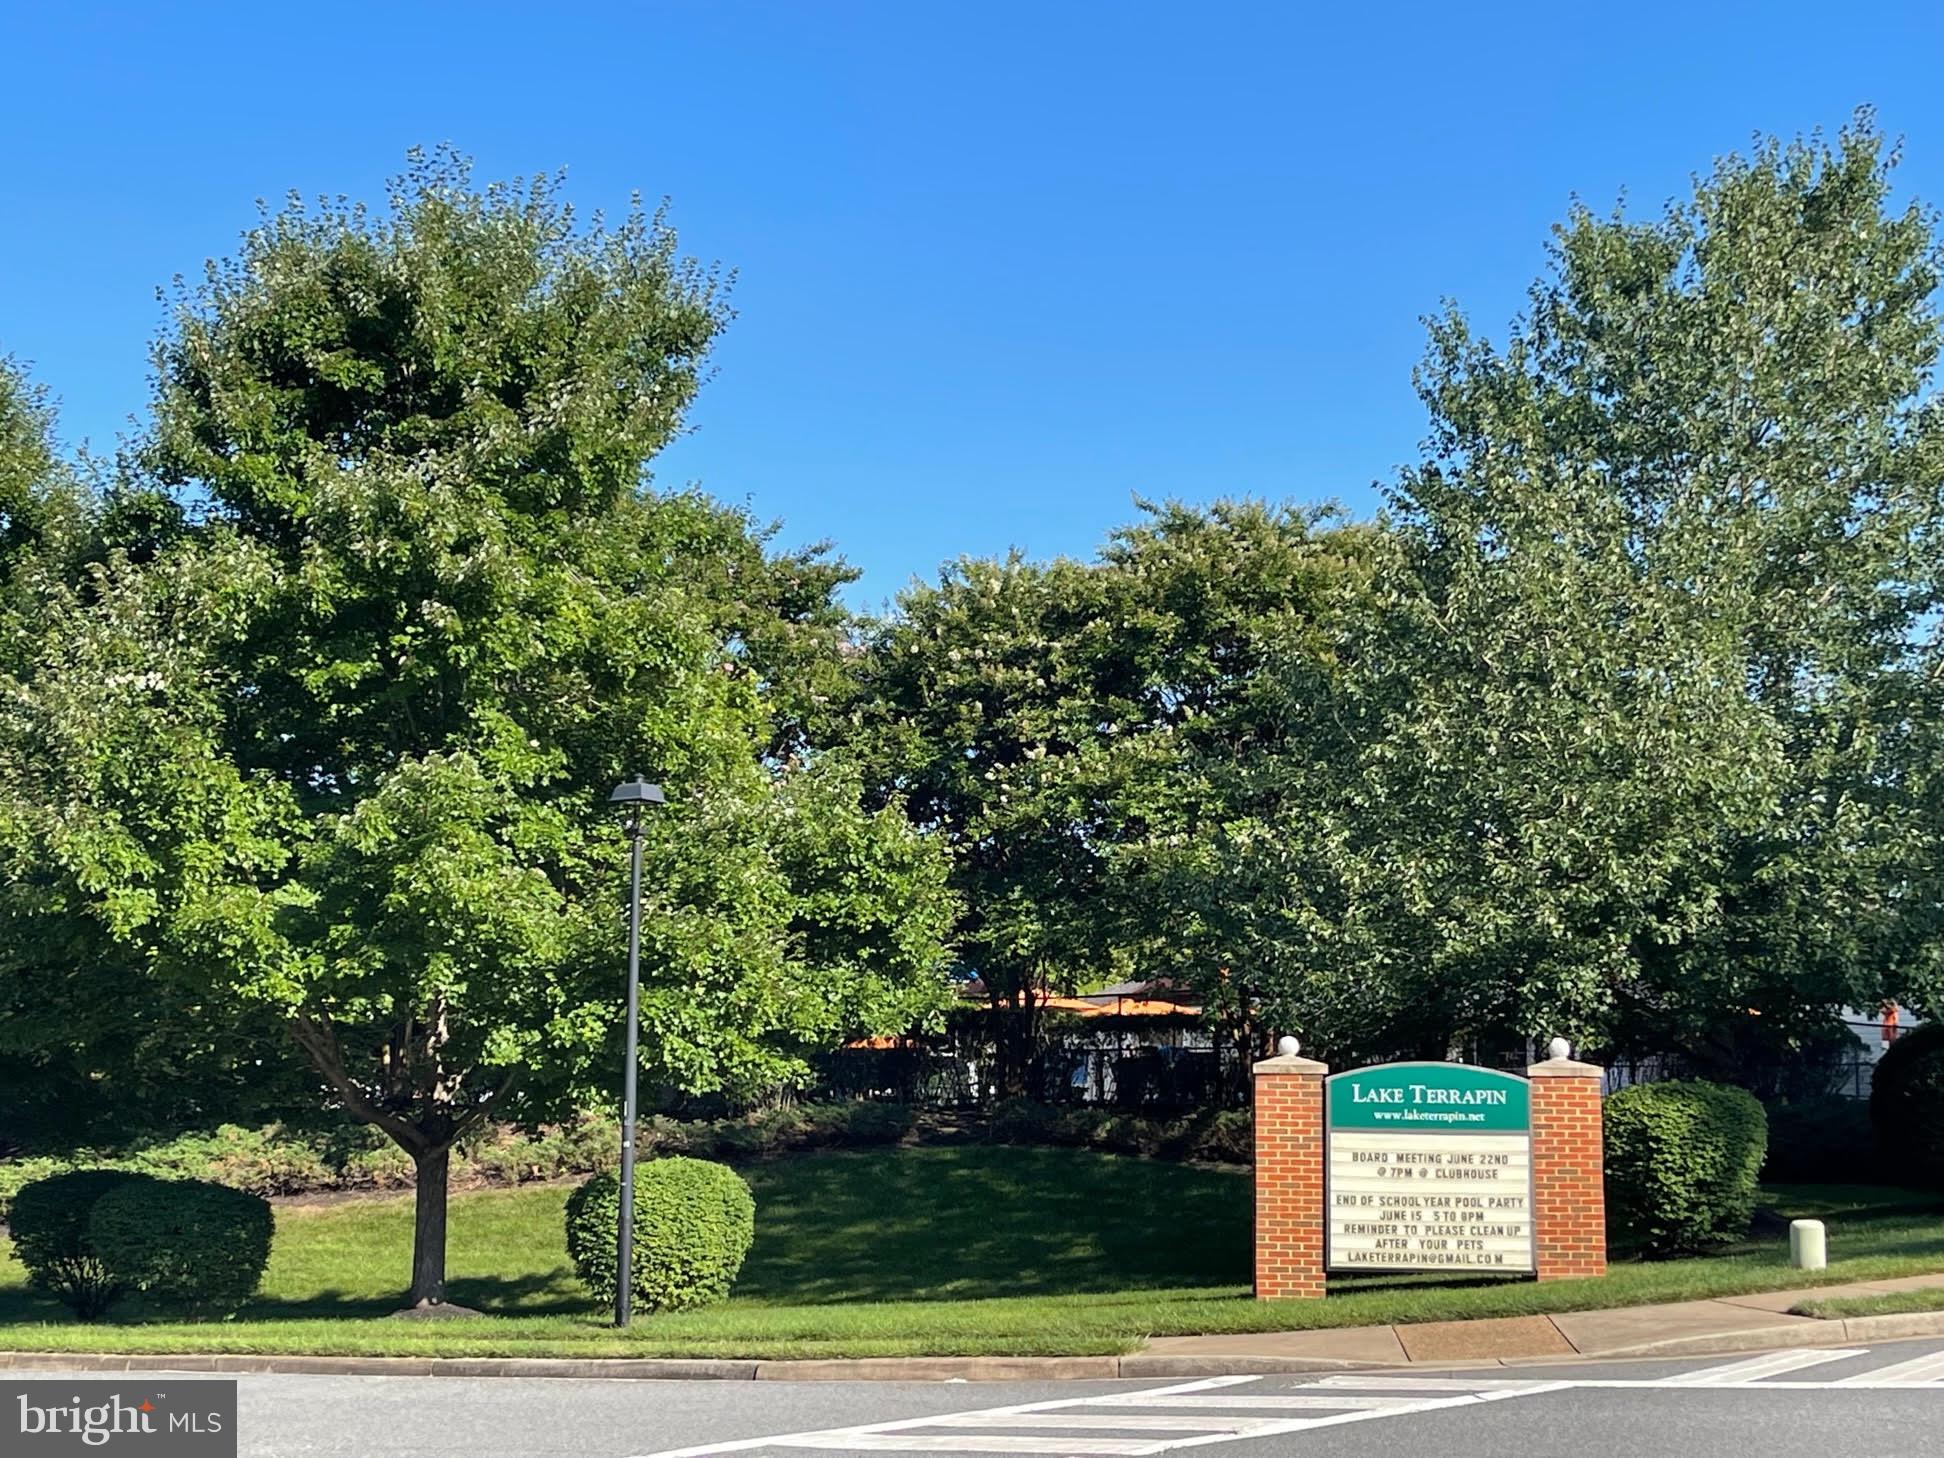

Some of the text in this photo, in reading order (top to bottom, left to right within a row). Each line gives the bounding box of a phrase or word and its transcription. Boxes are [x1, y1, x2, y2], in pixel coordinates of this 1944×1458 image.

[1352, 1084, 1506, 1104] LAKE TERRAPIN
[1374, 1110, 1485, 1122] www.laketerrapin.net
[1352, 1152, 1388, 1163] BOARD
[1396, 1153, 1442, 1164] MEETING
[1447, 1154, 1474, 1164] JUNE
[1391, 1168, 1412, 1177] 7PM
[1435, 1169, 1498, 1179] CLUBHOUSE
[1336, 1195, 1524, 1208] END OF SCHOOL YEAR POOL PARTY
[1379, 1211, 1407, 1221] JUNE
[1411, 1211, 1422, 1221] 15
[1442, 1212, 1456, 1221] TO
[1344, 1224, 1520, 1236] REMINDER TO PLEASE CLEAN UP
[1375, 1239, 1483, 1250] AFTER YOUR PETS
